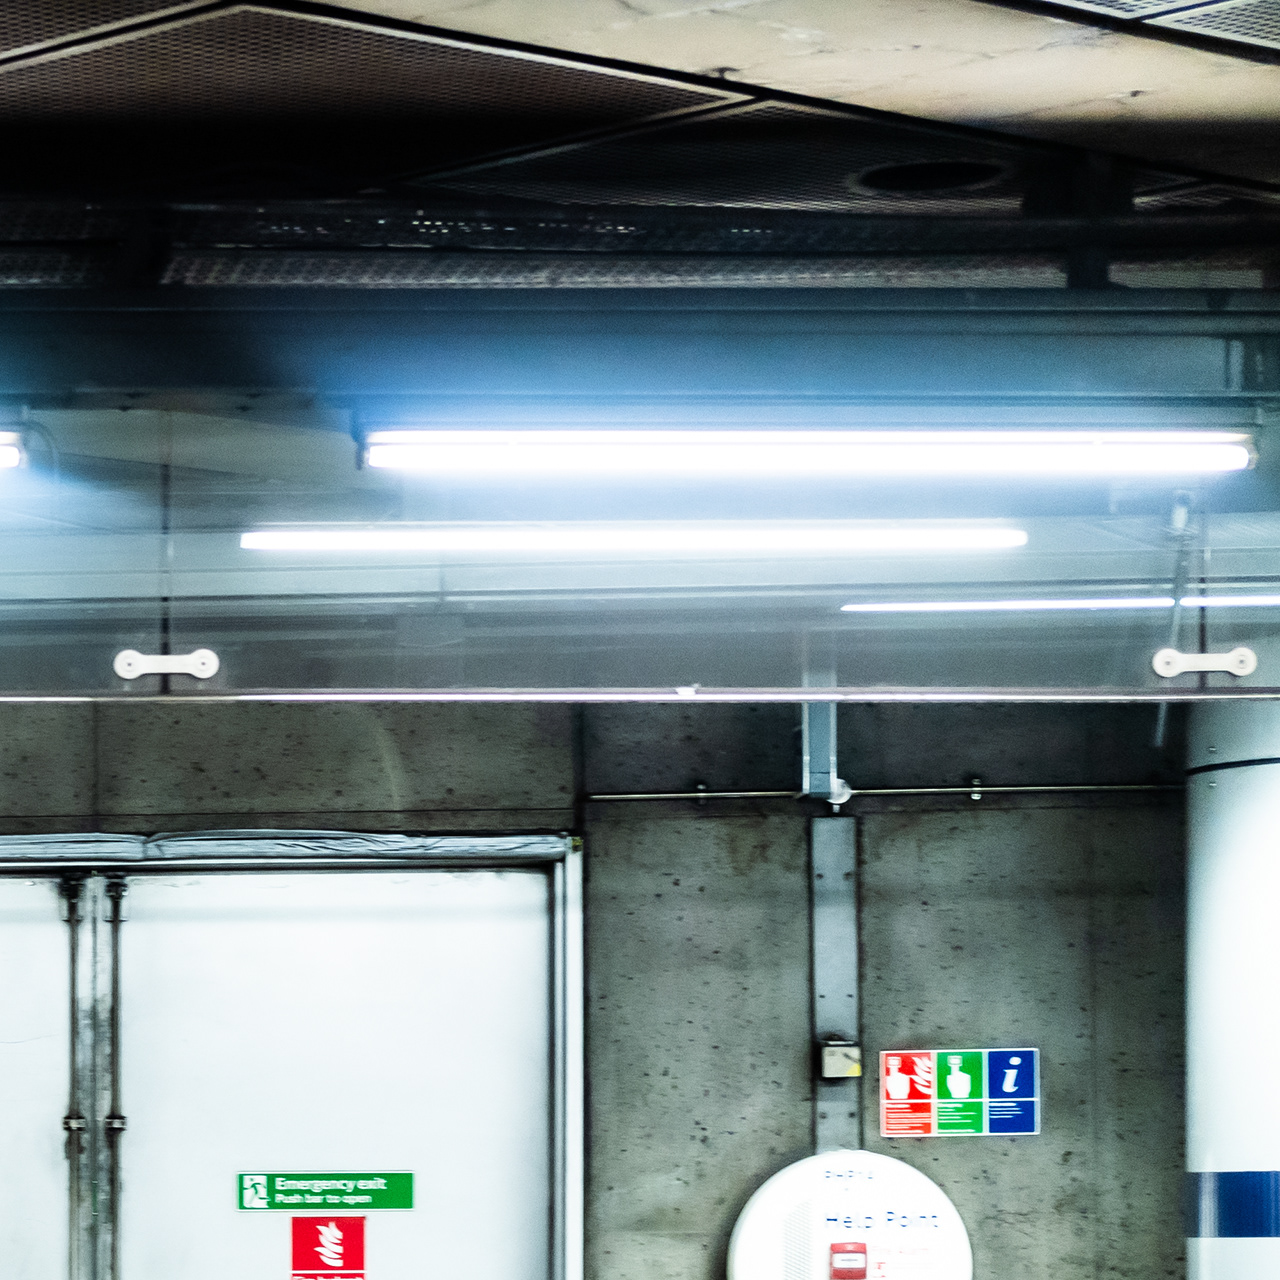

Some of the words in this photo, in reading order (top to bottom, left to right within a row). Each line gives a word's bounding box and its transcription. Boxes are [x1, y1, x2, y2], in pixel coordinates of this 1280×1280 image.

[275, 1177, 356, 1192] Emergency
[357, 1177, 388, 1190] exit
[275, 1193, 303, 1203] Push
[304, 1193, 325, 1203] bar
[326, 1195, 340, 1203] to
[341, 1195, 372, 1205] open
[824, 1211, 875, 1232] Help
[885, 1210, 939, 1229] Point
